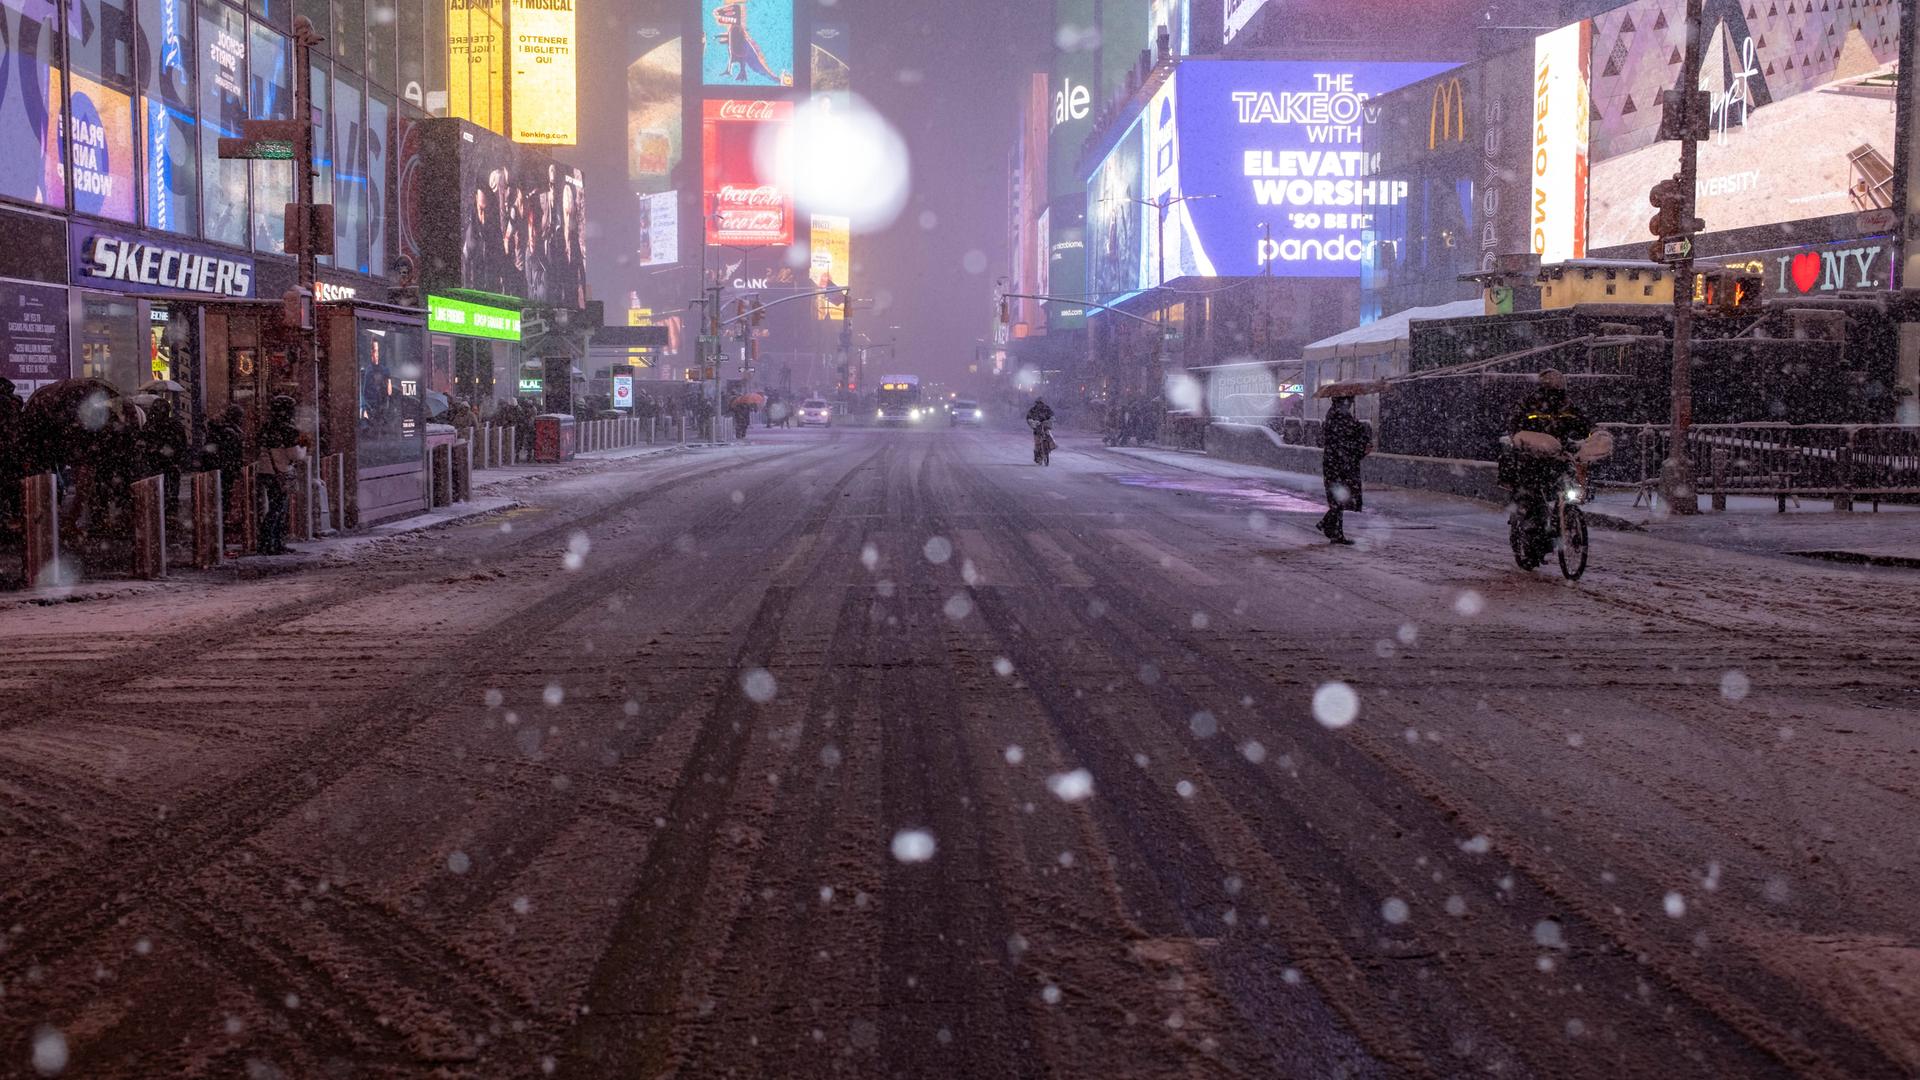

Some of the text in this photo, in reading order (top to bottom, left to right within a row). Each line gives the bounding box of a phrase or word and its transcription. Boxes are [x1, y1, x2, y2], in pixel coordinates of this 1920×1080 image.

[519, 35, 568, 44] OTTENERE
[524, 45, 569, 55] BIGLIETTI
[535, 56, 553, 64] QUI
[1313, 73, 1354, 92] THE
[1231, 91, 1383, 125] TAKEOV
[1536, 65, 1549, 176] OPEN
[520, 131, 569, 140] lionking.com
[1306, 125, 1362, 144] WITH
[1243, 150, 1381, 177] ELEVATI
[1252, 179, 1408, 206] WORSHIP
[1324, 213, 1348, 229] BE
[92, 237, 251, 297] SKECHERS
[1777, 255, 1791, 294] I
